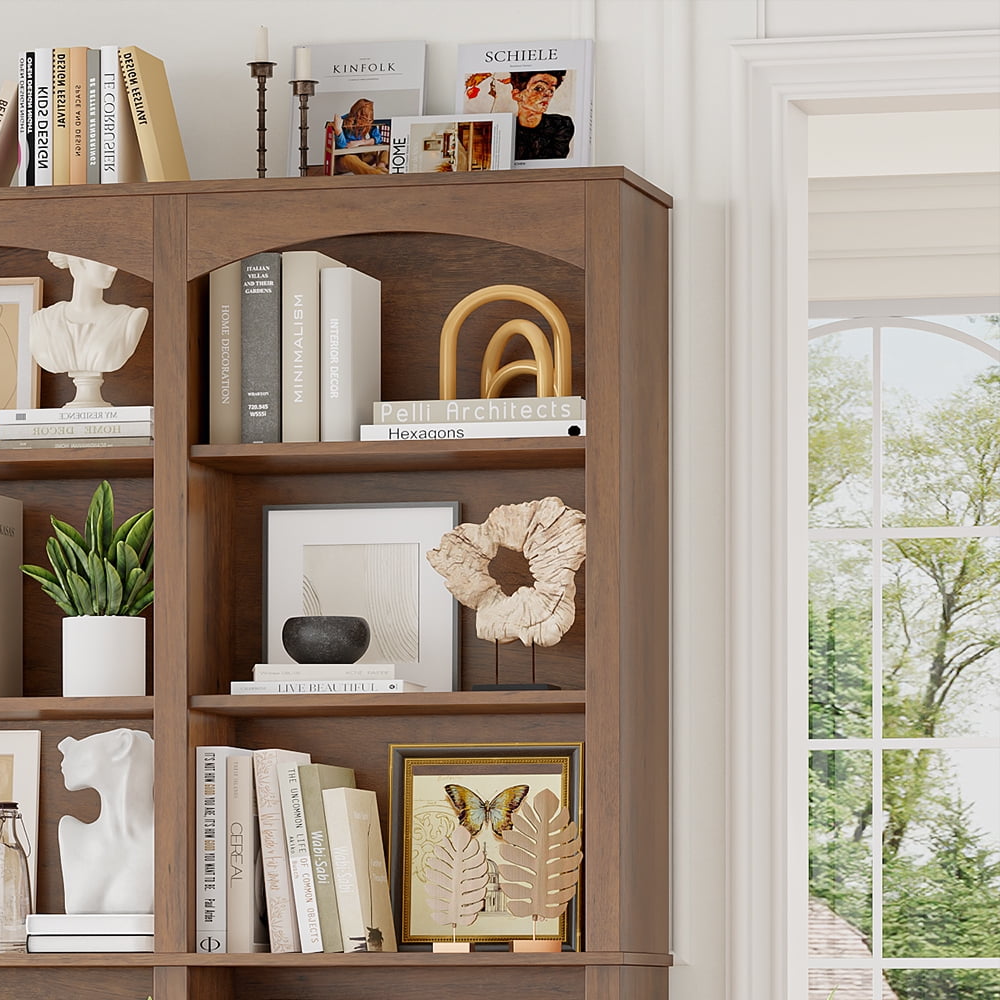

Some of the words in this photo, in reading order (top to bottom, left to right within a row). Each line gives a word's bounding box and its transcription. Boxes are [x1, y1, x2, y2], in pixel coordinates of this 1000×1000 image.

[332, 62, 396, 74] KINFOLK
[484, 48, 558, 63] SCHIELE
[392, 136, 406, 175] HOME
[221, 304, 230, 336] HOME
[293, 294, 304, 403] MINIMALISM
[330, 318, 339, 364] INTERIOR
[221, 338, 230, 404] DECORATION
[330, 366, 339, 399] DECOR
[380, 402, 431, 424] Pelli
[446, 400, 572, 421] Architects
[388, 426, 465, 440] Hexagons
[278, 683, 306, 694] LIVE
[309, 682, 379, 693] BEAUTIFUL
[287, 768, 296, 784] THE
[290, 788, 304, 829] UNCOMMON
[230, 821, 244, 889] CEREAL
[296, 833, 307, 854] LIFE
[310, 830, 330, 885] Wabi-Sabi
[300, 857, 309, 868] OF
[302, 873, 313, 903] COMMON
[306, 907, 319, 944] OBJECTS
